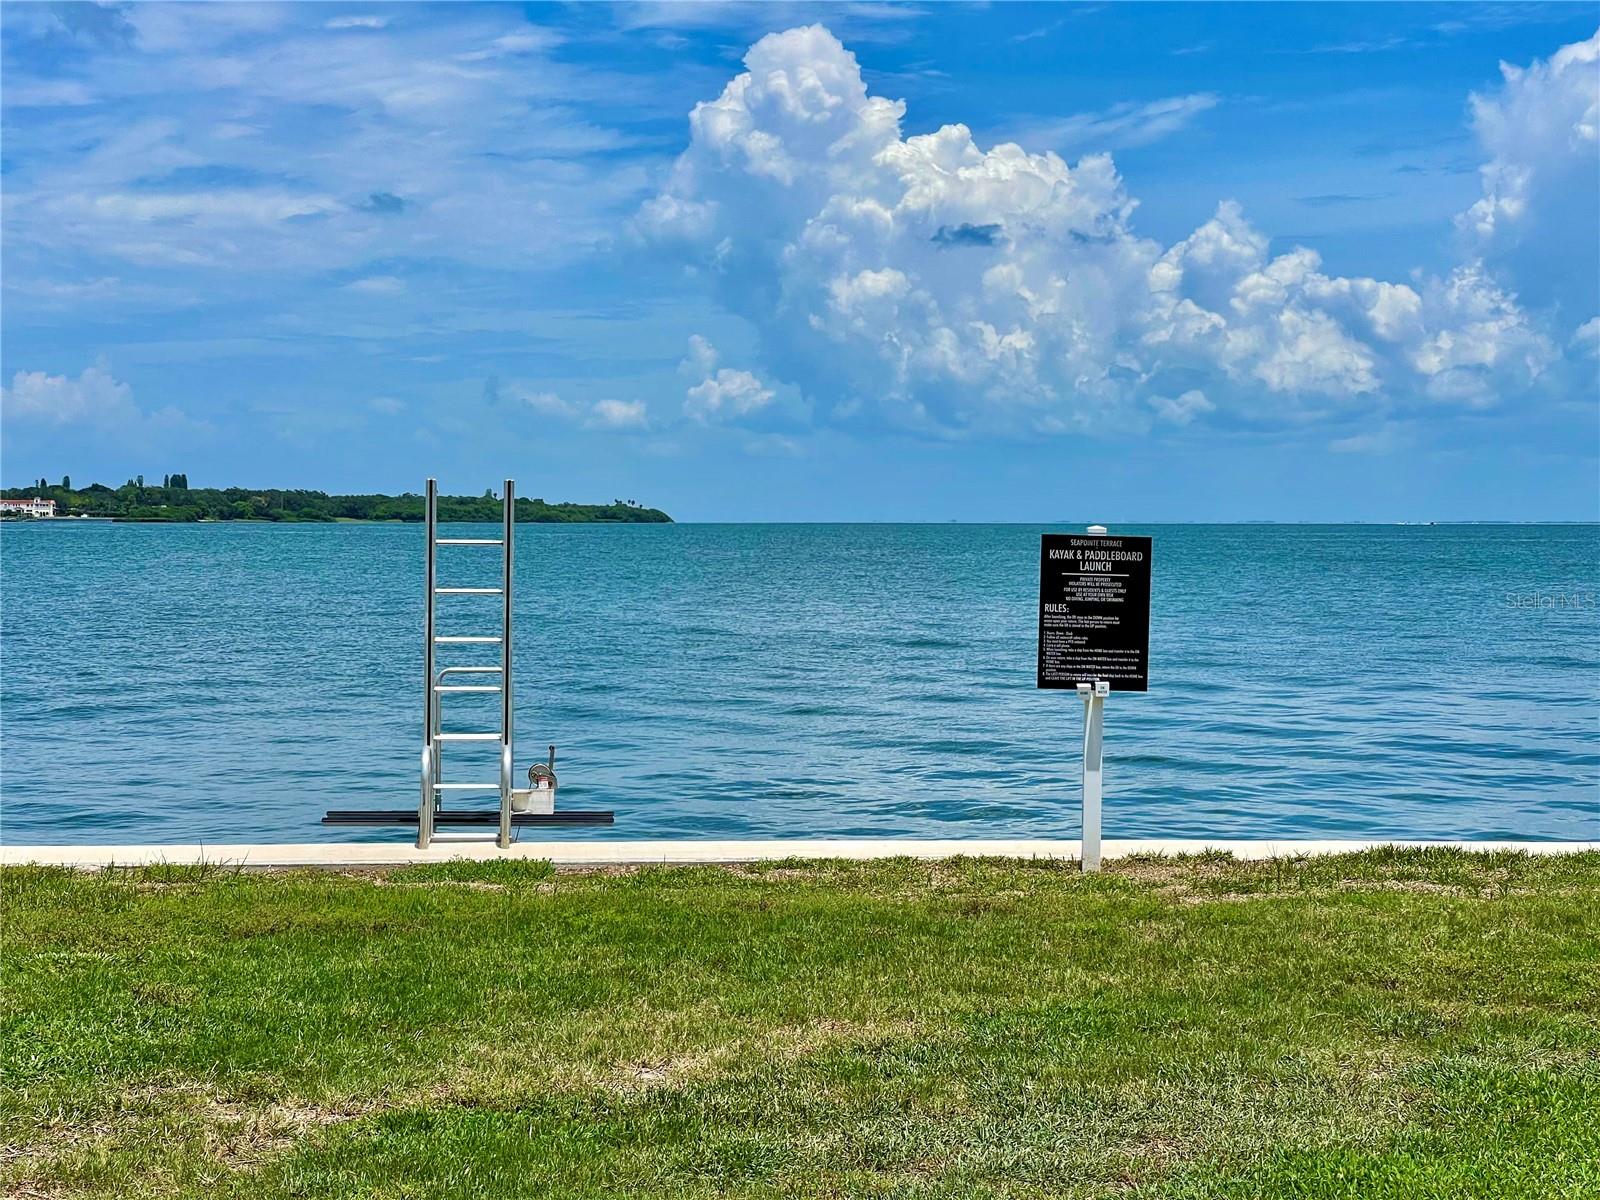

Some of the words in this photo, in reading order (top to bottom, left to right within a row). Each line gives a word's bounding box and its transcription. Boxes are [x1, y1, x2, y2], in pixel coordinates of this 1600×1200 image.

[1070, 539, 1099, 547] SEAPOINTE
[1049, 549, 1075, 560] KAYAK
[1076, 550, 1083, 560] &
[1084, 550, 1143, 562] PADDLEBOARD
[1079, 561, 1112, 572] LAUNCH
[1044, 603, 1070, 613] RULES:
